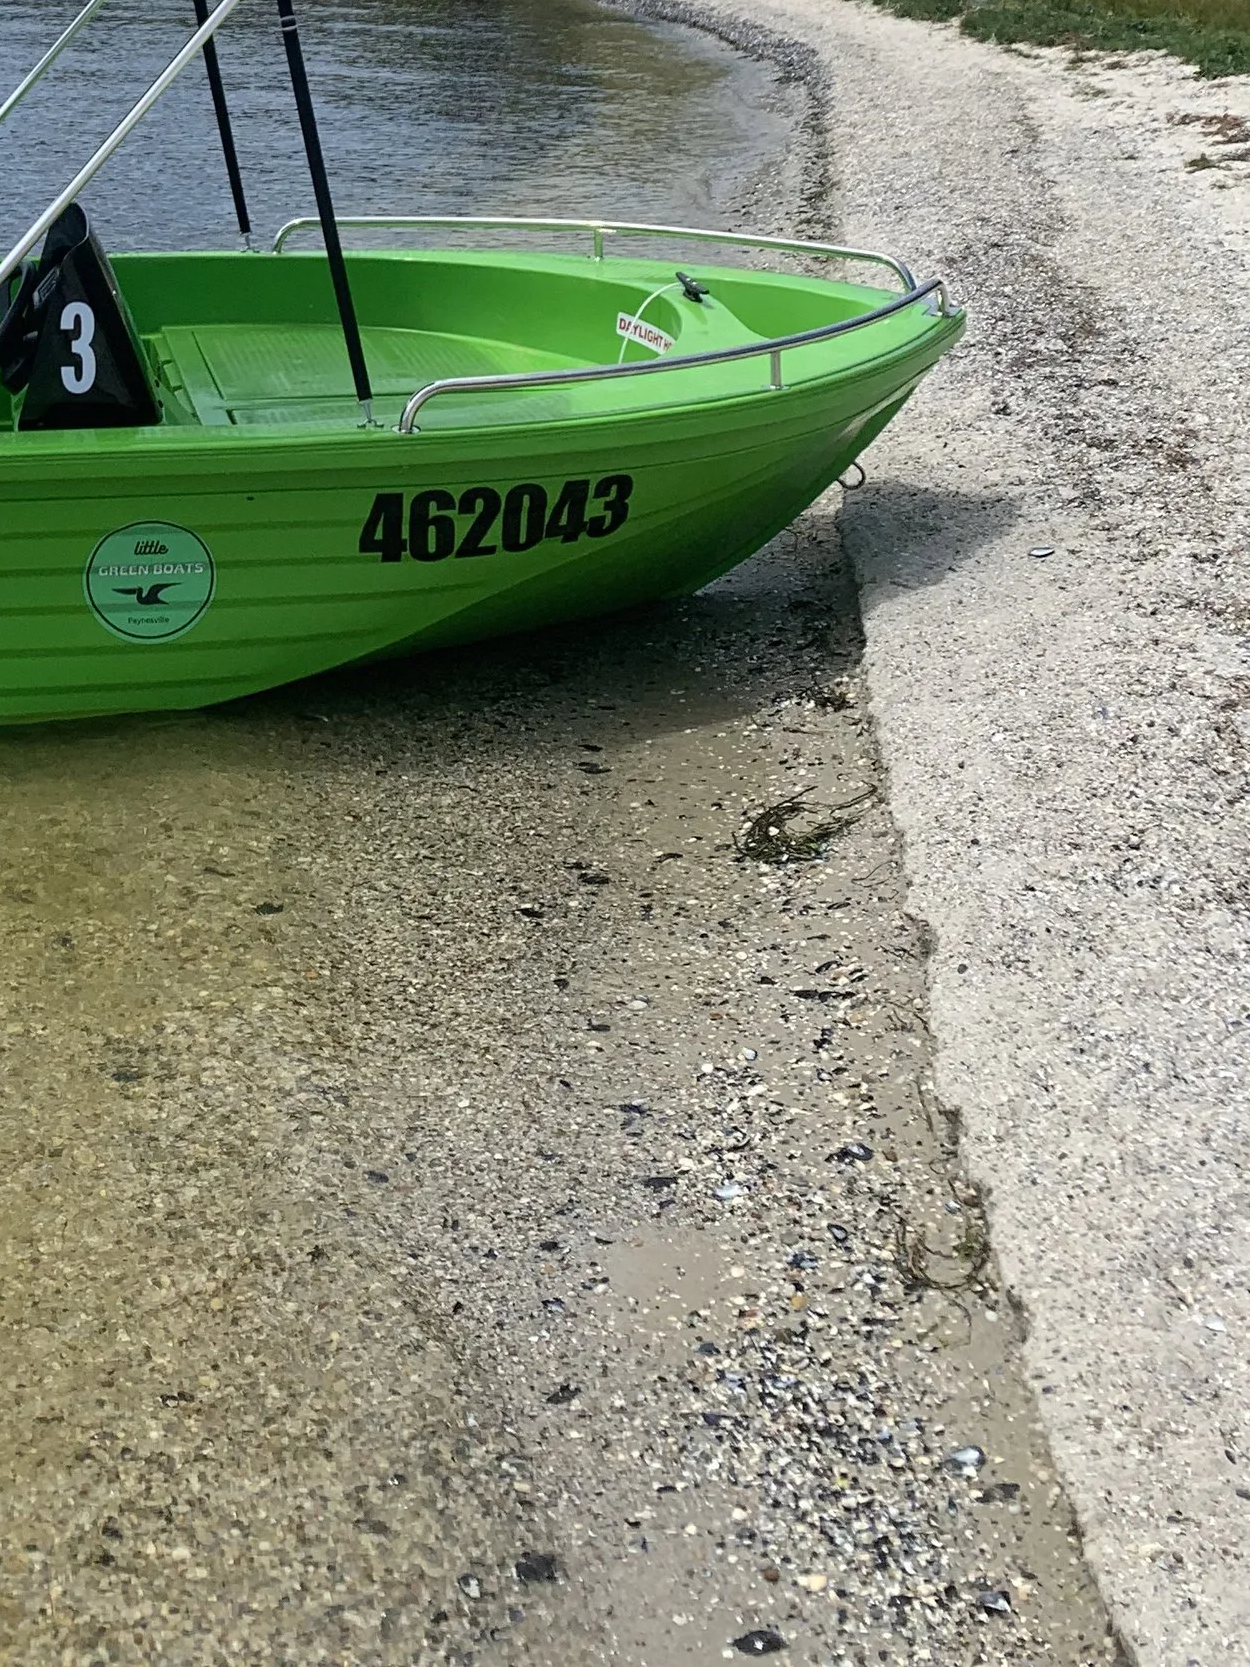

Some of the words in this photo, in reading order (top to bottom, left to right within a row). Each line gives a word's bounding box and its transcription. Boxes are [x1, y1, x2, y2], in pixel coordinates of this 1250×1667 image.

[60, 301, 97, 395] 3
[358, 473, 634, 563] 462043
[98, 565, 149, 576] GREEN
[153, 562, 205, 575] BOATS
[133, 540, 170, 556] little
